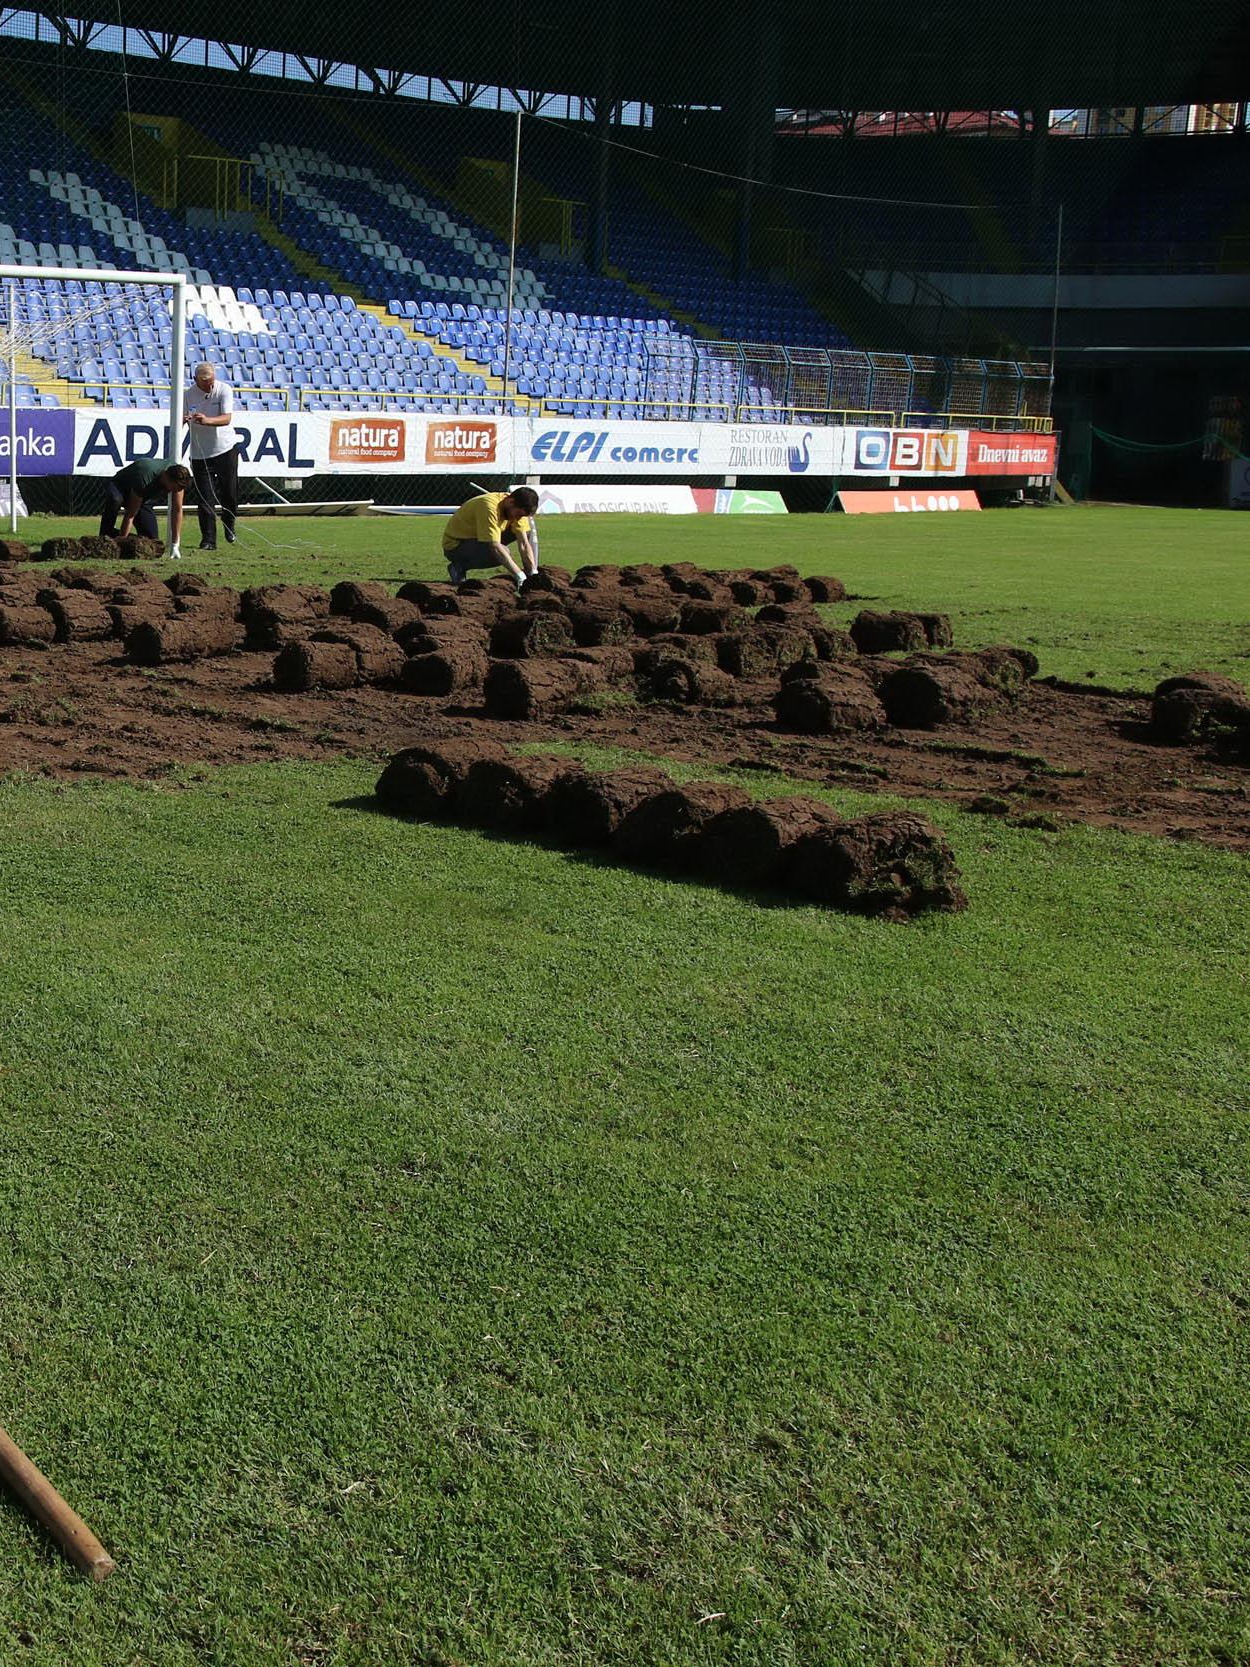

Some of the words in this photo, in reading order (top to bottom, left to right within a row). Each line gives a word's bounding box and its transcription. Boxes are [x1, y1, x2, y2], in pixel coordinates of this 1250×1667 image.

[338, 424, 399, 448] natura
[434, 426, 491, 449] natura
[730, 429, 789, 444] RESTORAN
[360, 448, 372, 456] food
[373, 449, 398, 457] company
[465, 450, 488, 458] company
[531, 430, 609, 463] ELPI
[610, 446, 700, 464] comerc
[859, 436, 955, 467] OBN
[978, 444, 1020, 463] Dnevni
[1022, 448, 1048, 463] avaz
